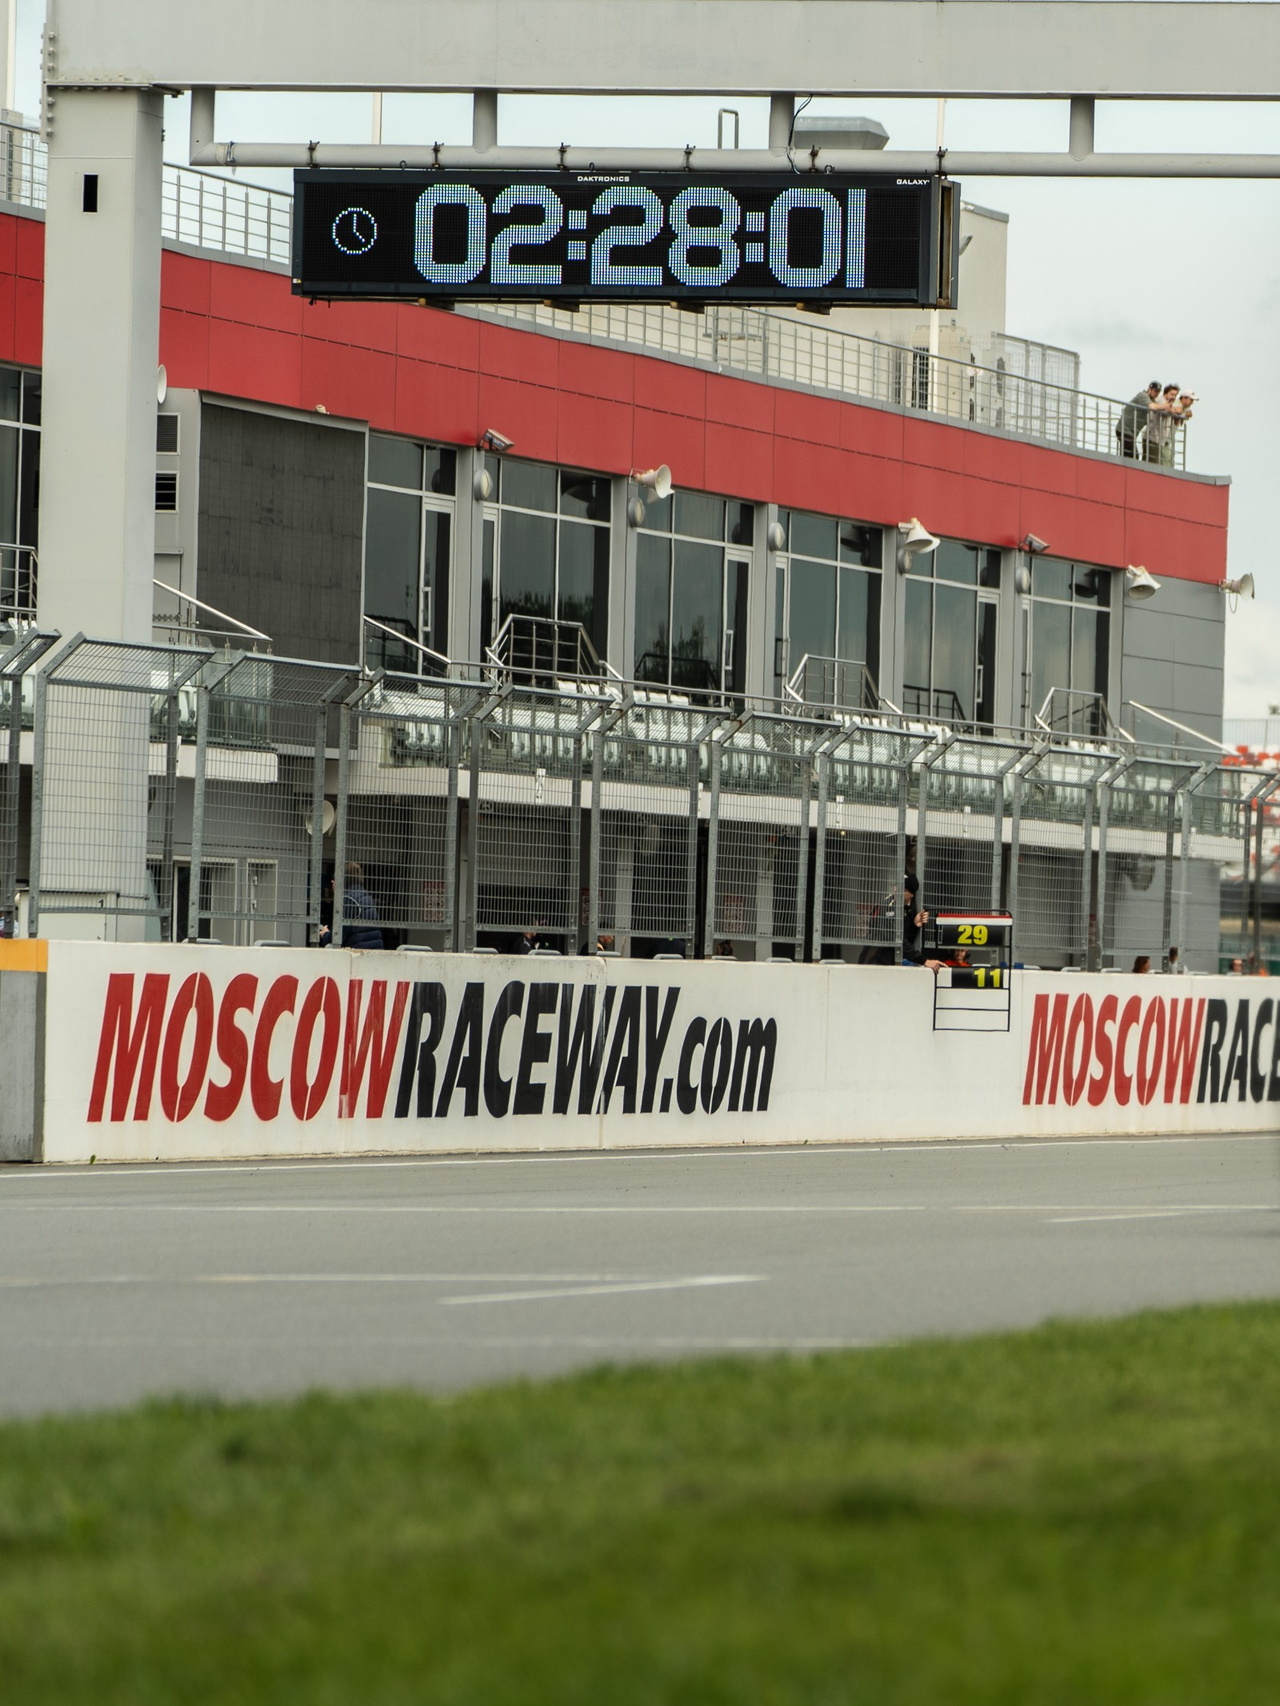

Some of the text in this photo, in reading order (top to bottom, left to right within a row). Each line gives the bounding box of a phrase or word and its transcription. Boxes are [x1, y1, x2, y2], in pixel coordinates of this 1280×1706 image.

[414, 183, 868, 289] 02:28:01
[957, 924, 989, 946] 29
[973, 967, 1001, 988] 11
[86, 971, 778, 1123] MOSCOWRACEWAY.com
